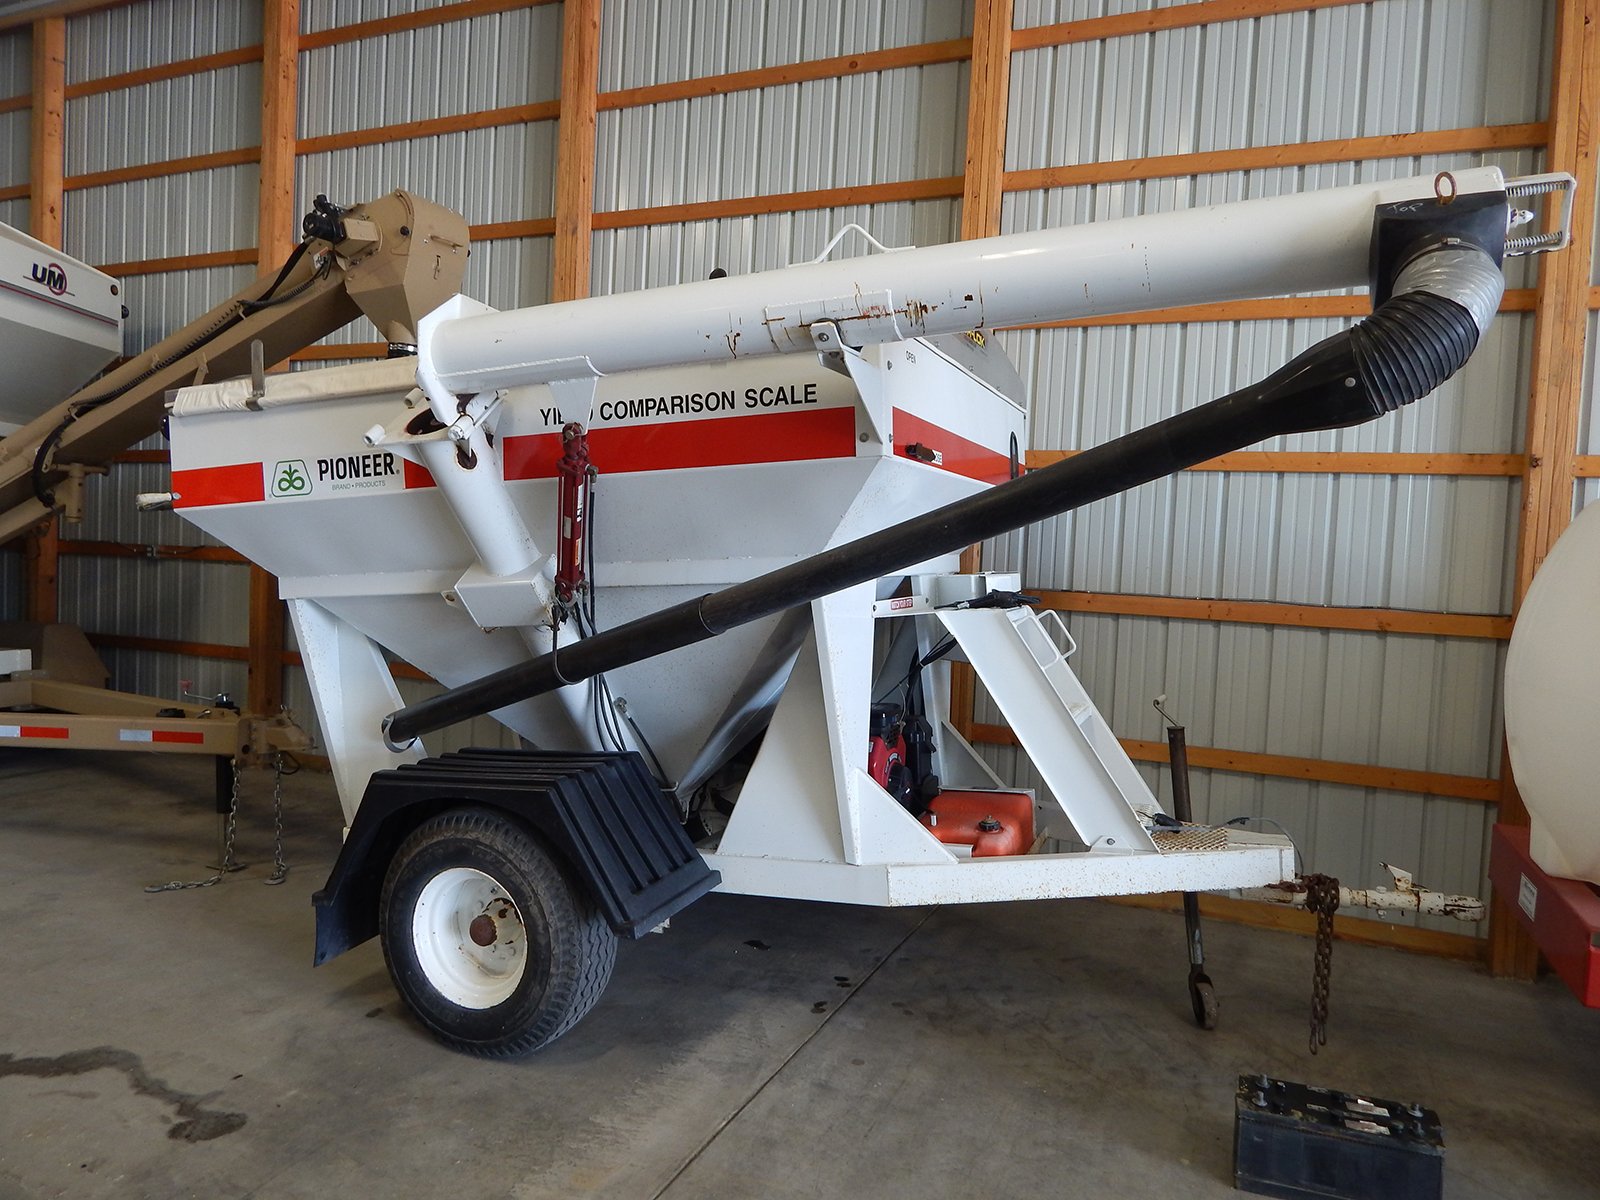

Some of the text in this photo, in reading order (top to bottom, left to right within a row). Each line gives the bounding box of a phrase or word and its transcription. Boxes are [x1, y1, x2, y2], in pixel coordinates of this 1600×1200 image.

[31, 262, 65, 291] UM
[905, 350, 917, 365] OPEN
[599, 390, 736, 421] COMPARISON
[744, 383, 818, 408] SCALE
[317, 453, 395, 481] PIONEER
